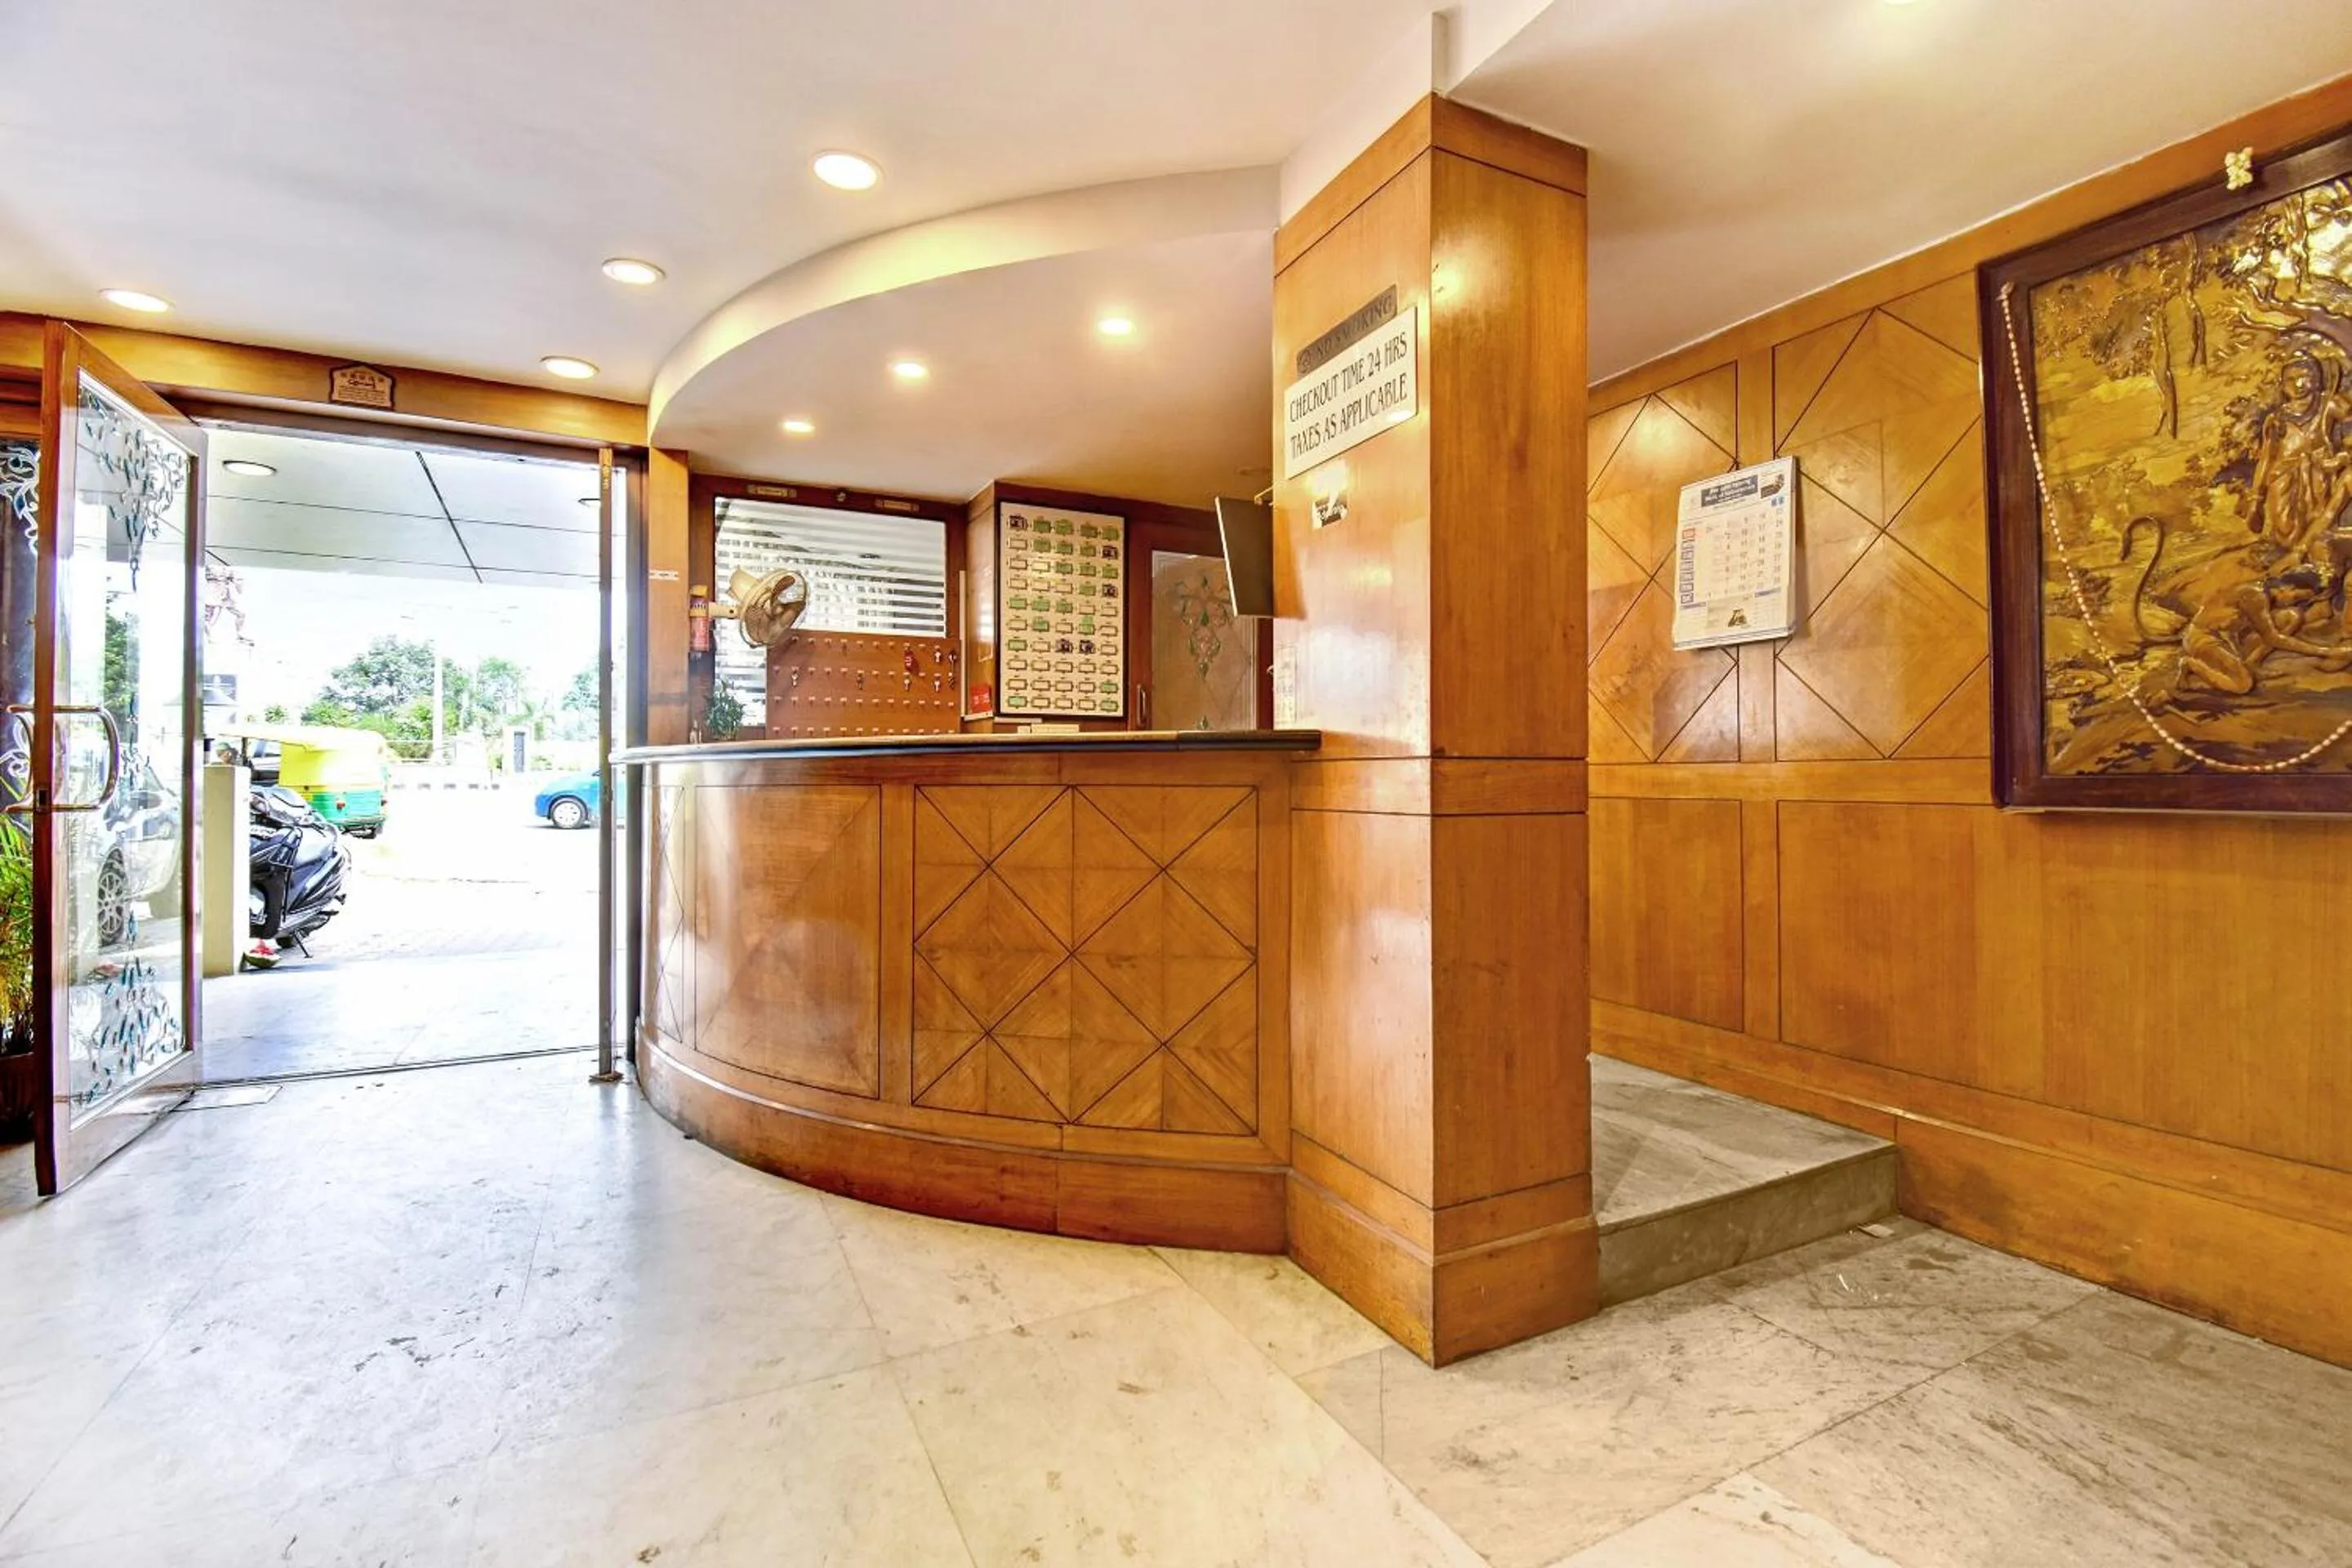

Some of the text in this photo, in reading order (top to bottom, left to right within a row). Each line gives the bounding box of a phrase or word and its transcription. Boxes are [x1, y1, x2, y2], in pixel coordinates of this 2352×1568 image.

[1290, 331, 1408, 423] CHECKOUT TIME 24 HRS
[1316, 336, 1333, 358] NO
[1290, 372, 1408, 460] TAXES AS APPLICABLE
